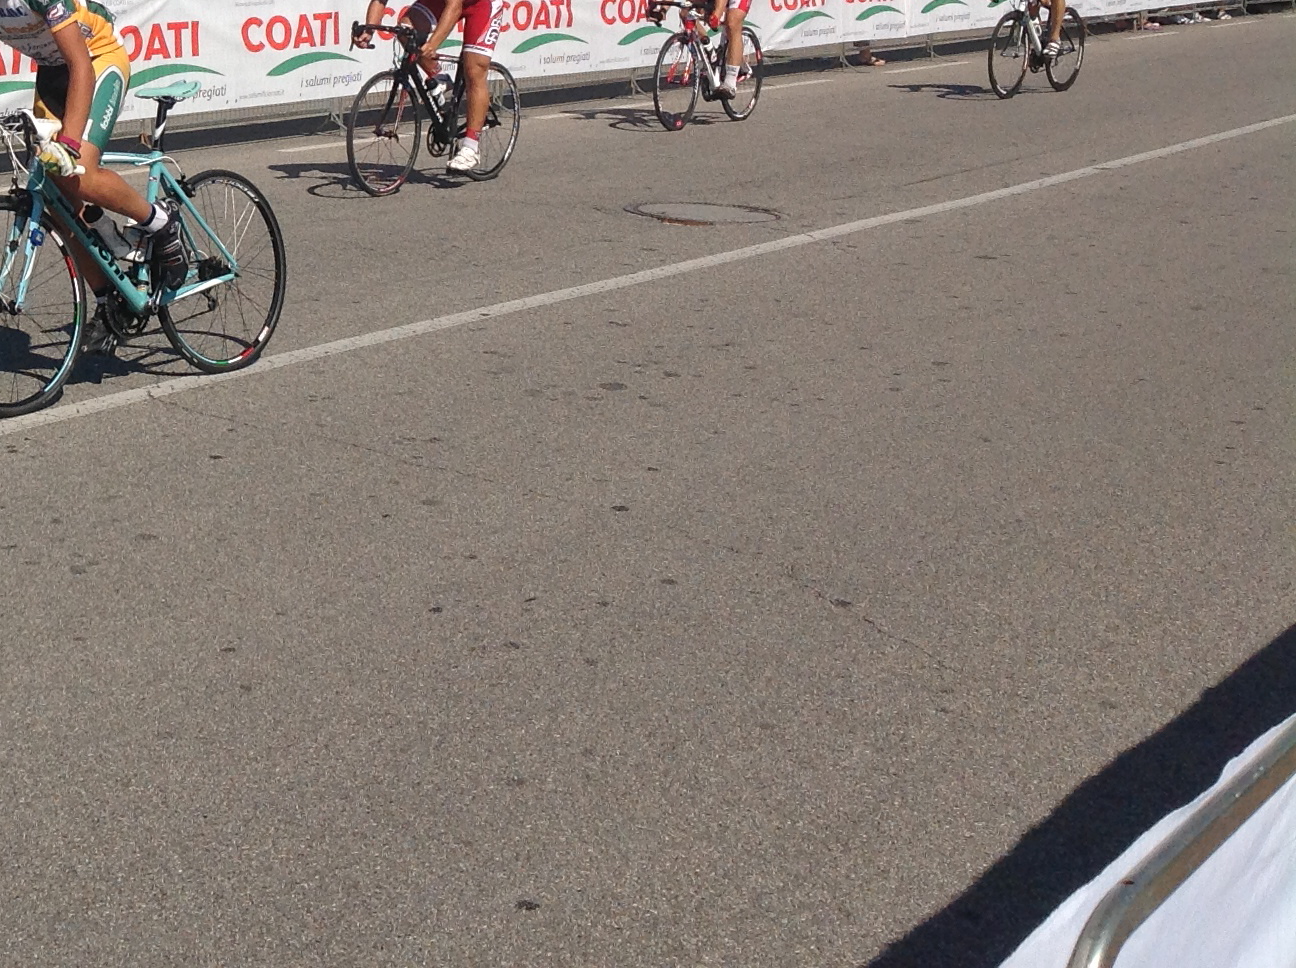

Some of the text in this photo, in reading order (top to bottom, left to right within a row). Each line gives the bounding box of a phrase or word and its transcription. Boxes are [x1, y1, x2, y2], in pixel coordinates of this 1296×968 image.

[241, 11, 339, 52] COATI
[305, 74, 332, 88] salumi
[332, 72, 363, 89] pregiati
